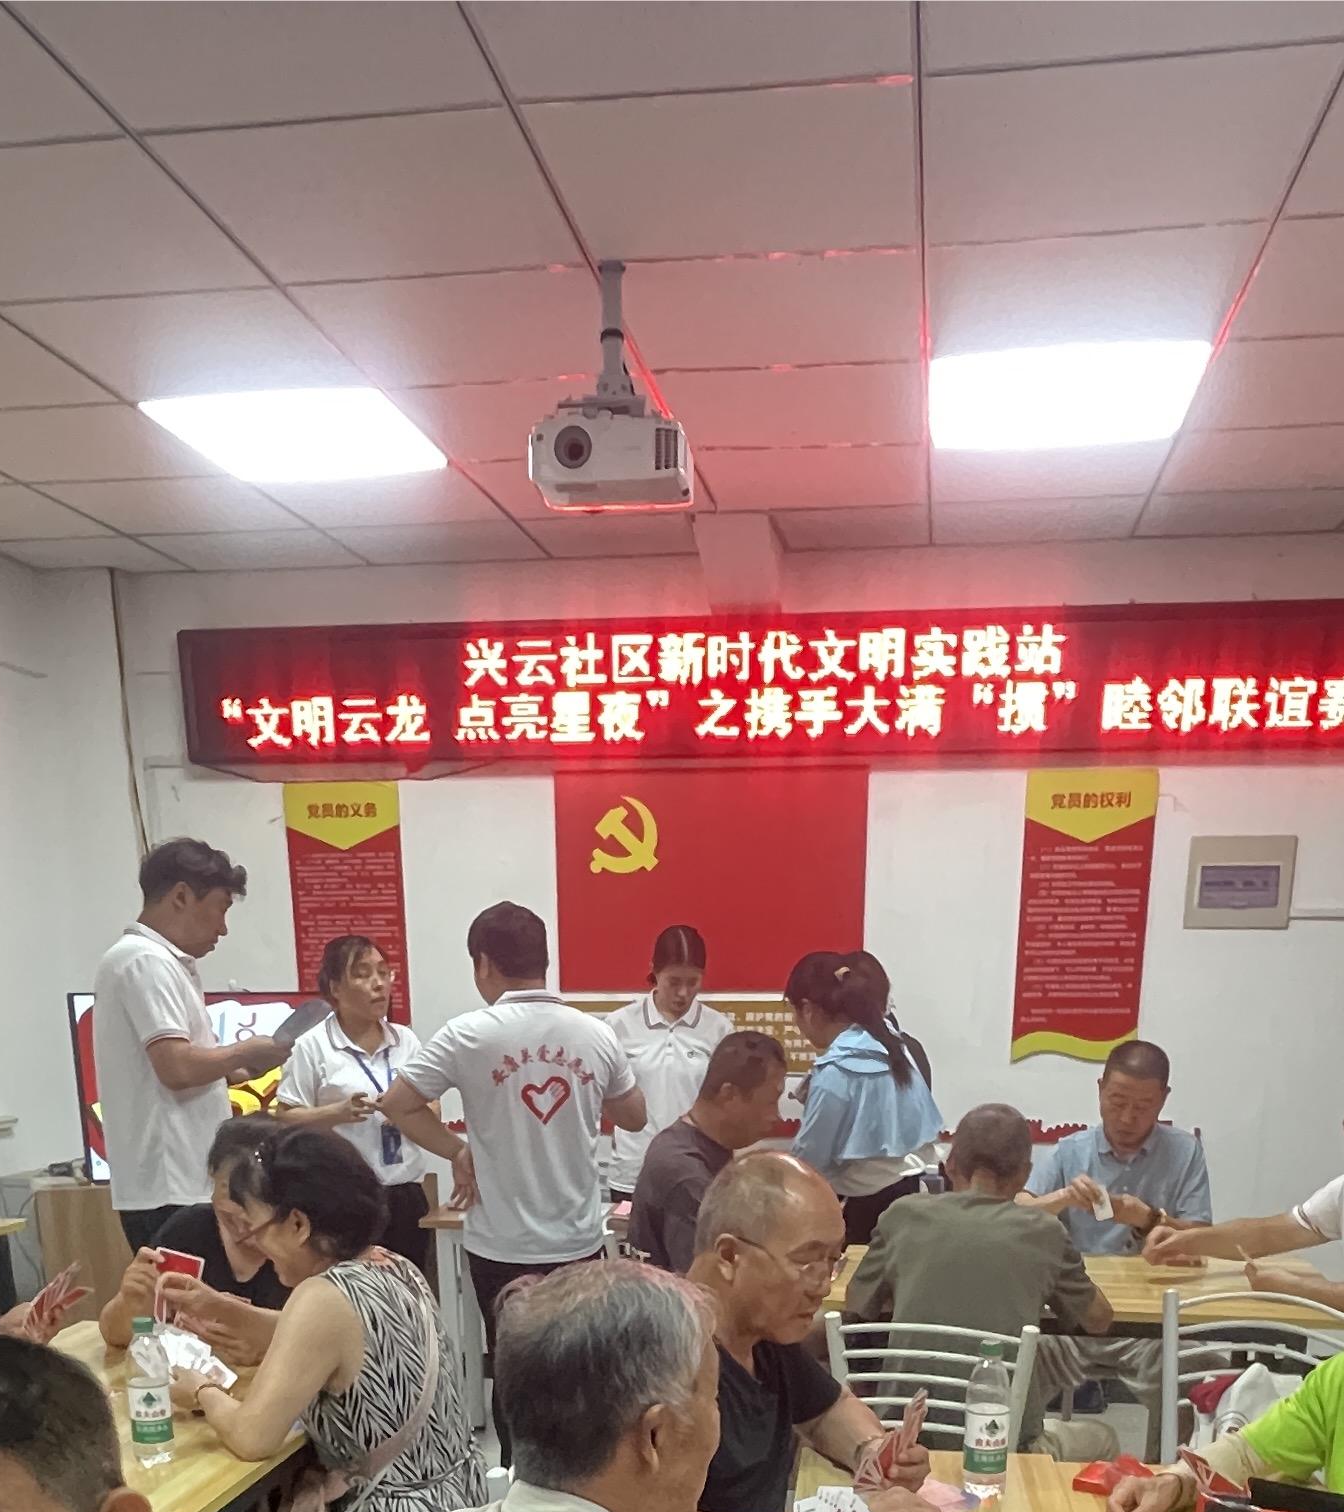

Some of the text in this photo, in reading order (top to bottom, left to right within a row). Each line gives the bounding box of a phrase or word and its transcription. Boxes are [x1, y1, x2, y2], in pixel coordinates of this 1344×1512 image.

[461, 624, 1066, 688] 兴云社区新时代文明实践站
[1050, 791, 1132, 809] 党员的权利
[307, 802, 377, 818] 党员的义务
